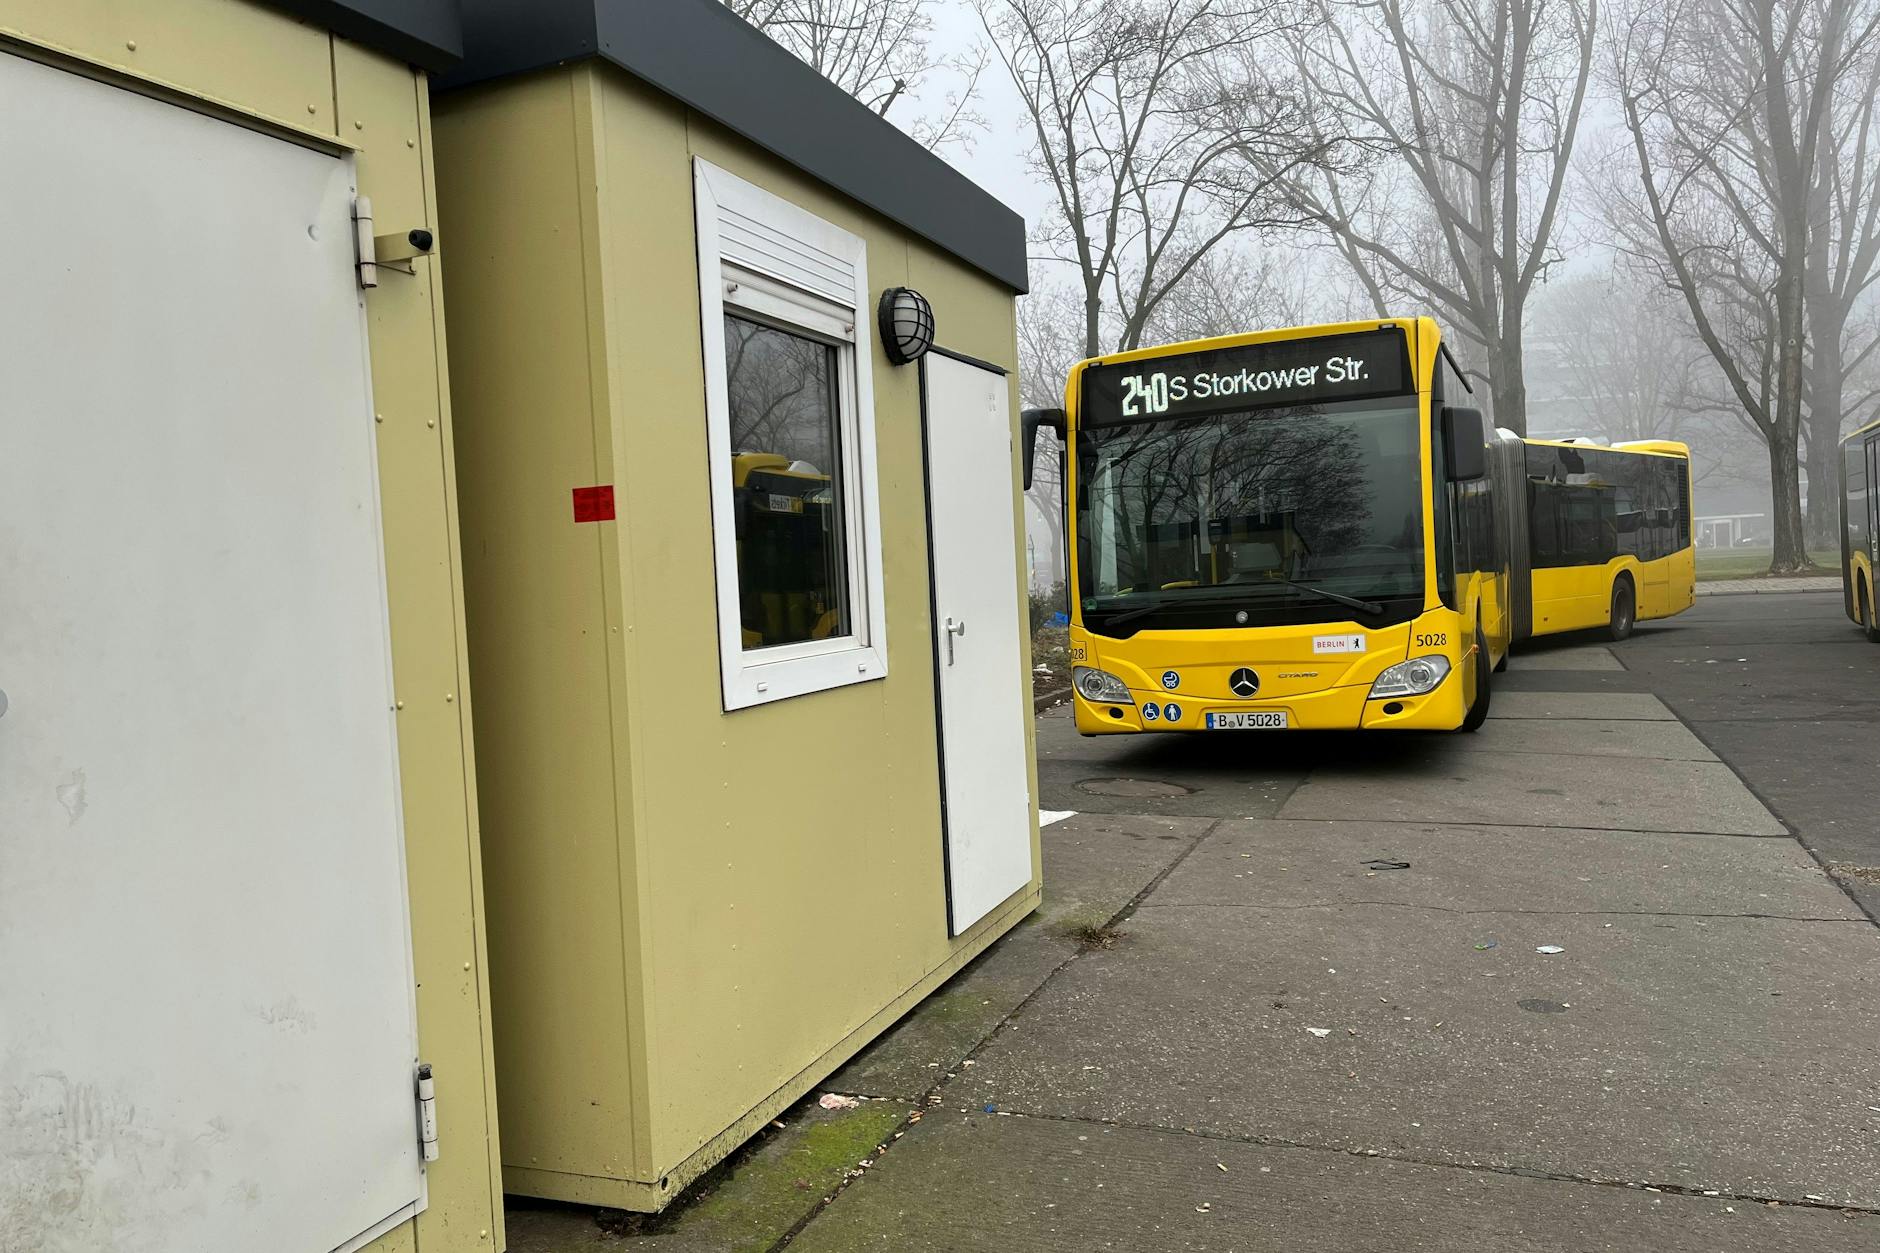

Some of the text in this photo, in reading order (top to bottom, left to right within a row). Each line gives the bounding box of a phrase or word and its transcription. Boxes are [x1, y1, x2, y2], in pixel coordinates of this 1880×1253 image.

[1120, 356, 1369, 416] 240 S Storkower Str.
[1316, 640, 1345, 648] BERLIN
[1416, 633, 1447, 647] 5028
[1218, 713, 1281, 727] B V 5028
